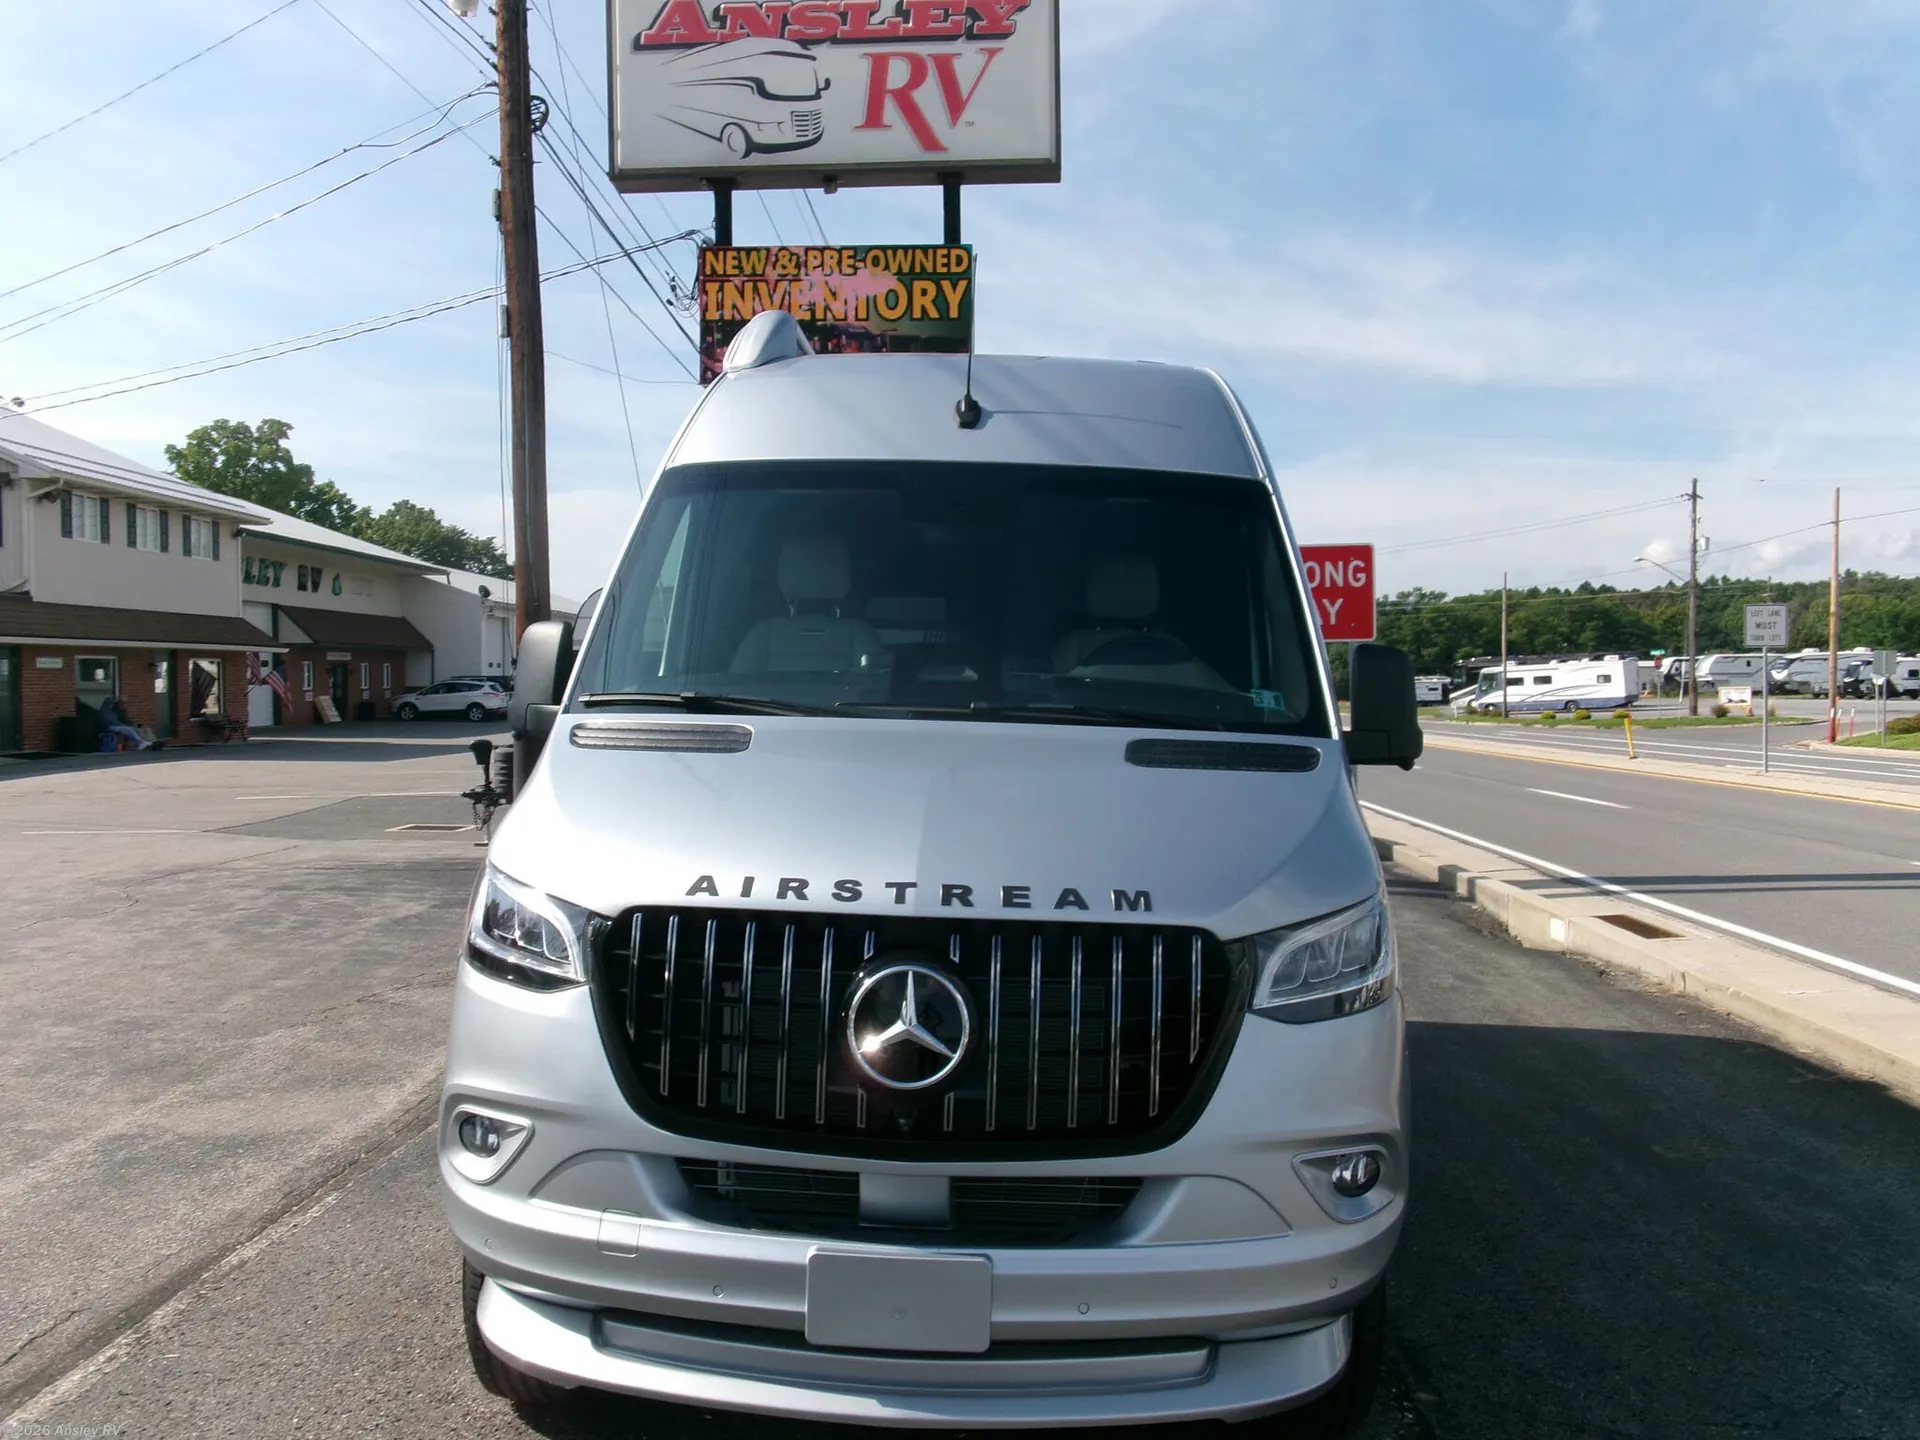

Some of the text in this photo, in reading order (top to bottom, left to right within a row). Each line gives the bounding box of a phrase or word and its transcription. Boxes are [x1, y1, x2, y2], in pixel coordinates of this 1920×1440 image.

[635, 0, 1030, 49] ANSLEY
[853, 47, 1004, 152] RV
[704, 247, 969, 276] NEW & PRE-OWNED
[704, 278, 970, 321] INVENTORY
[242, 555, 287, 588] LEY
[297, 564, 323, 593] RV
[1304, 560, 1367, 588] ONG
[685, 875, 1153, 913] AIRSTREAM
